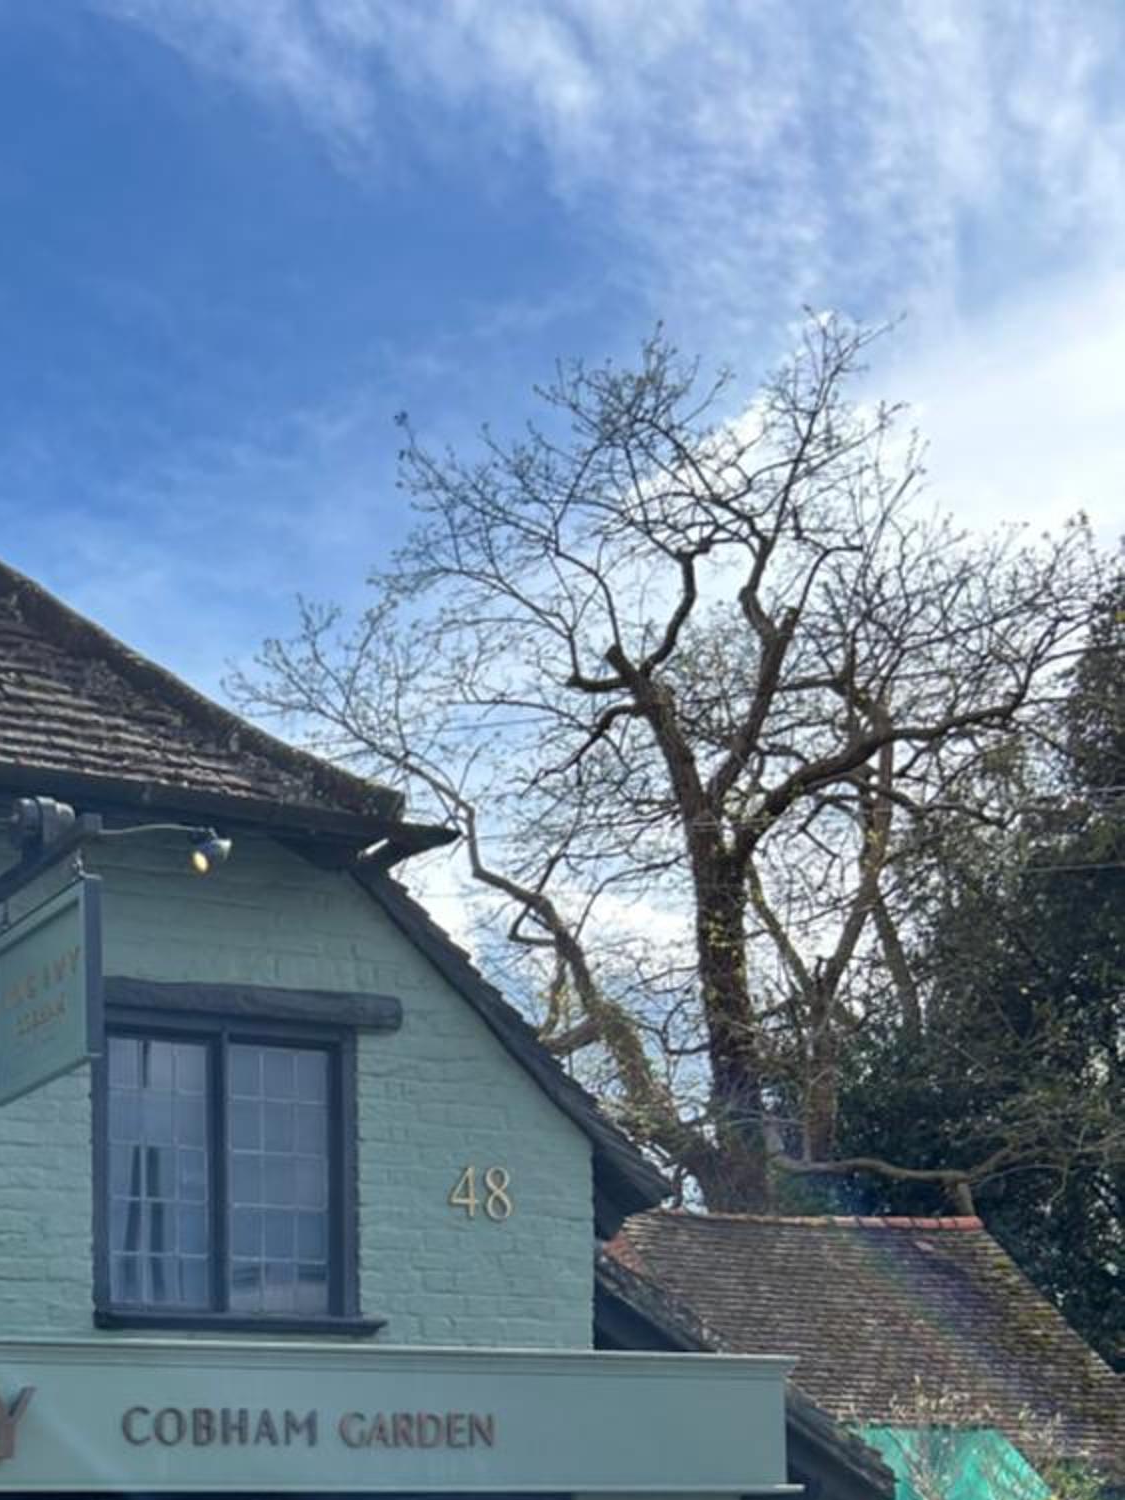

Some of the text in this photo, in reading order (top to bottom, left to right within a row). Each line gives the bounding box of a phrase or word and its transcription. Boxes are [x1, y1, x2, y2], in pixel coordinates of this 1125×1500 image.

[451, 1167, 511, 1219] 48
[121, 1406, 496, 1449] COBHAM GARDEN
